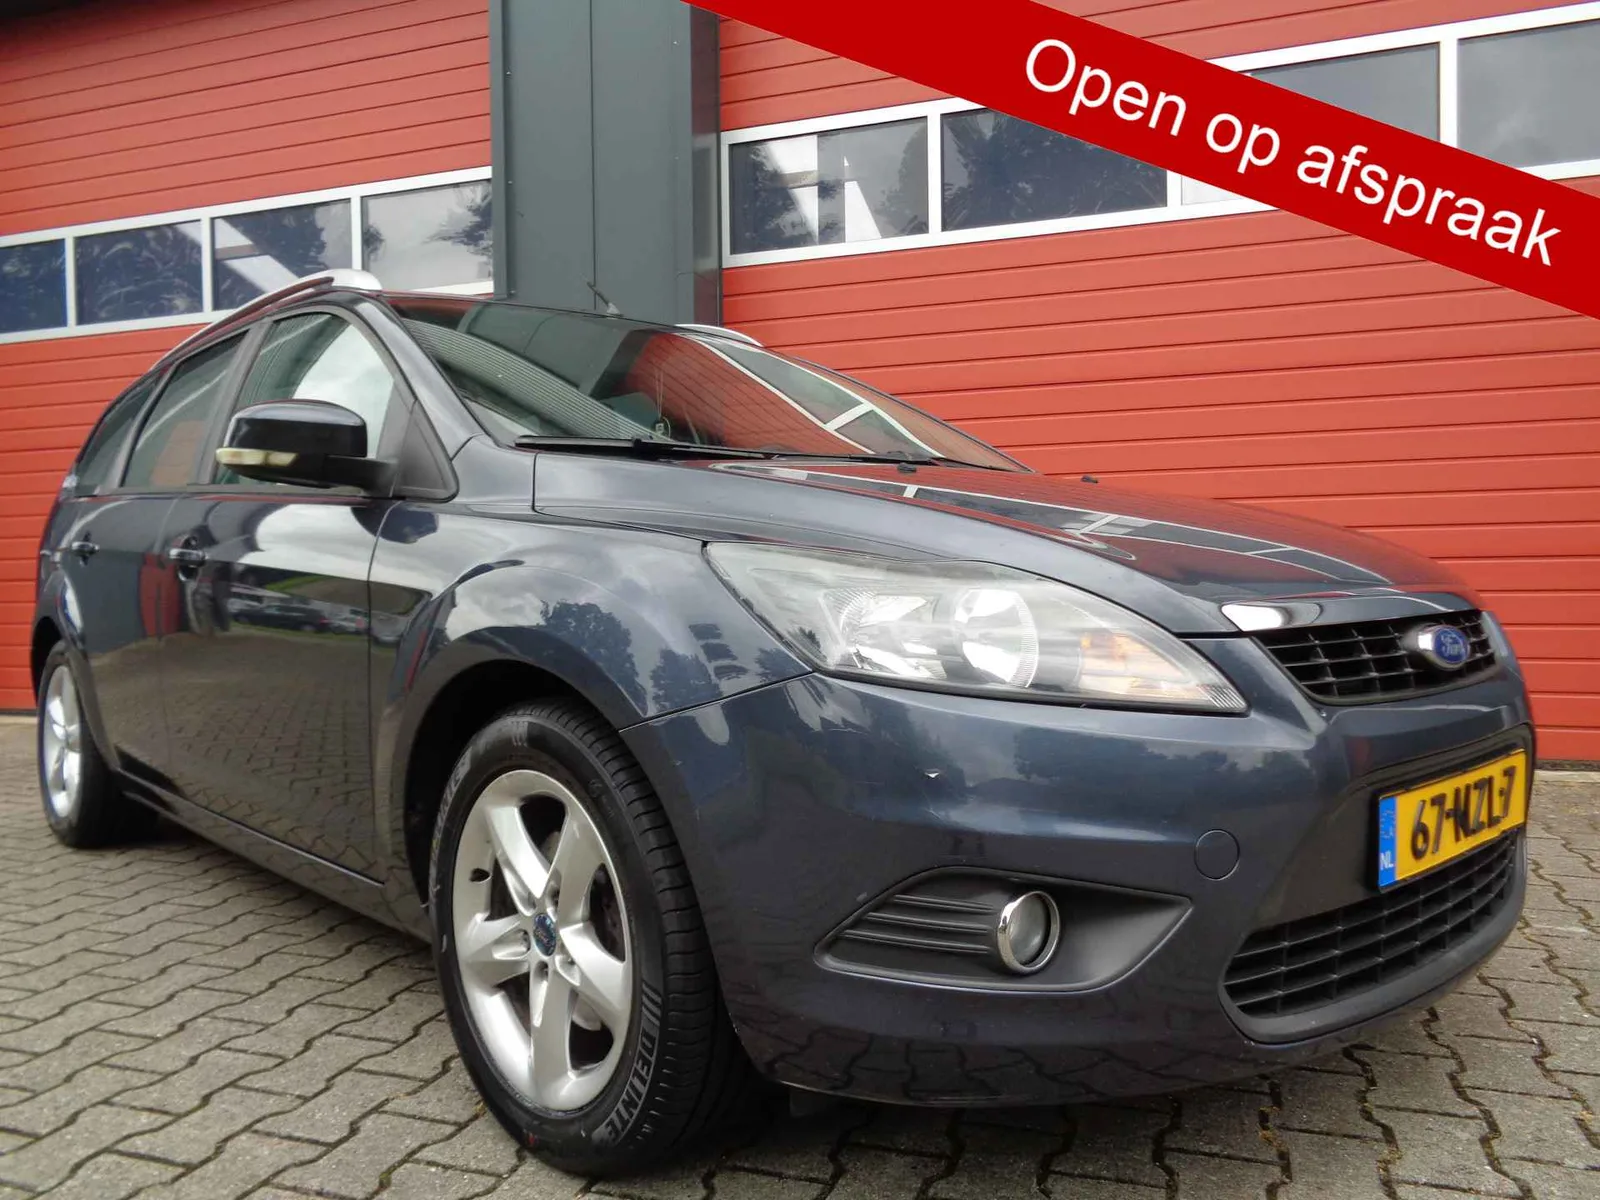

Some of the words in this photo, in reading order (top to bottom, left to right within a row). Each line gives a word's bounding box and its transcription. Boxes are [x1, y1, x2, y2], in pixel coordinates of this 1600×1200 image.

[1411, 765, 1517, 860] 67-NZL-7
[1379, 851, 1394, 870] NL
[602, 1026, 660, 1145] DELINTE
